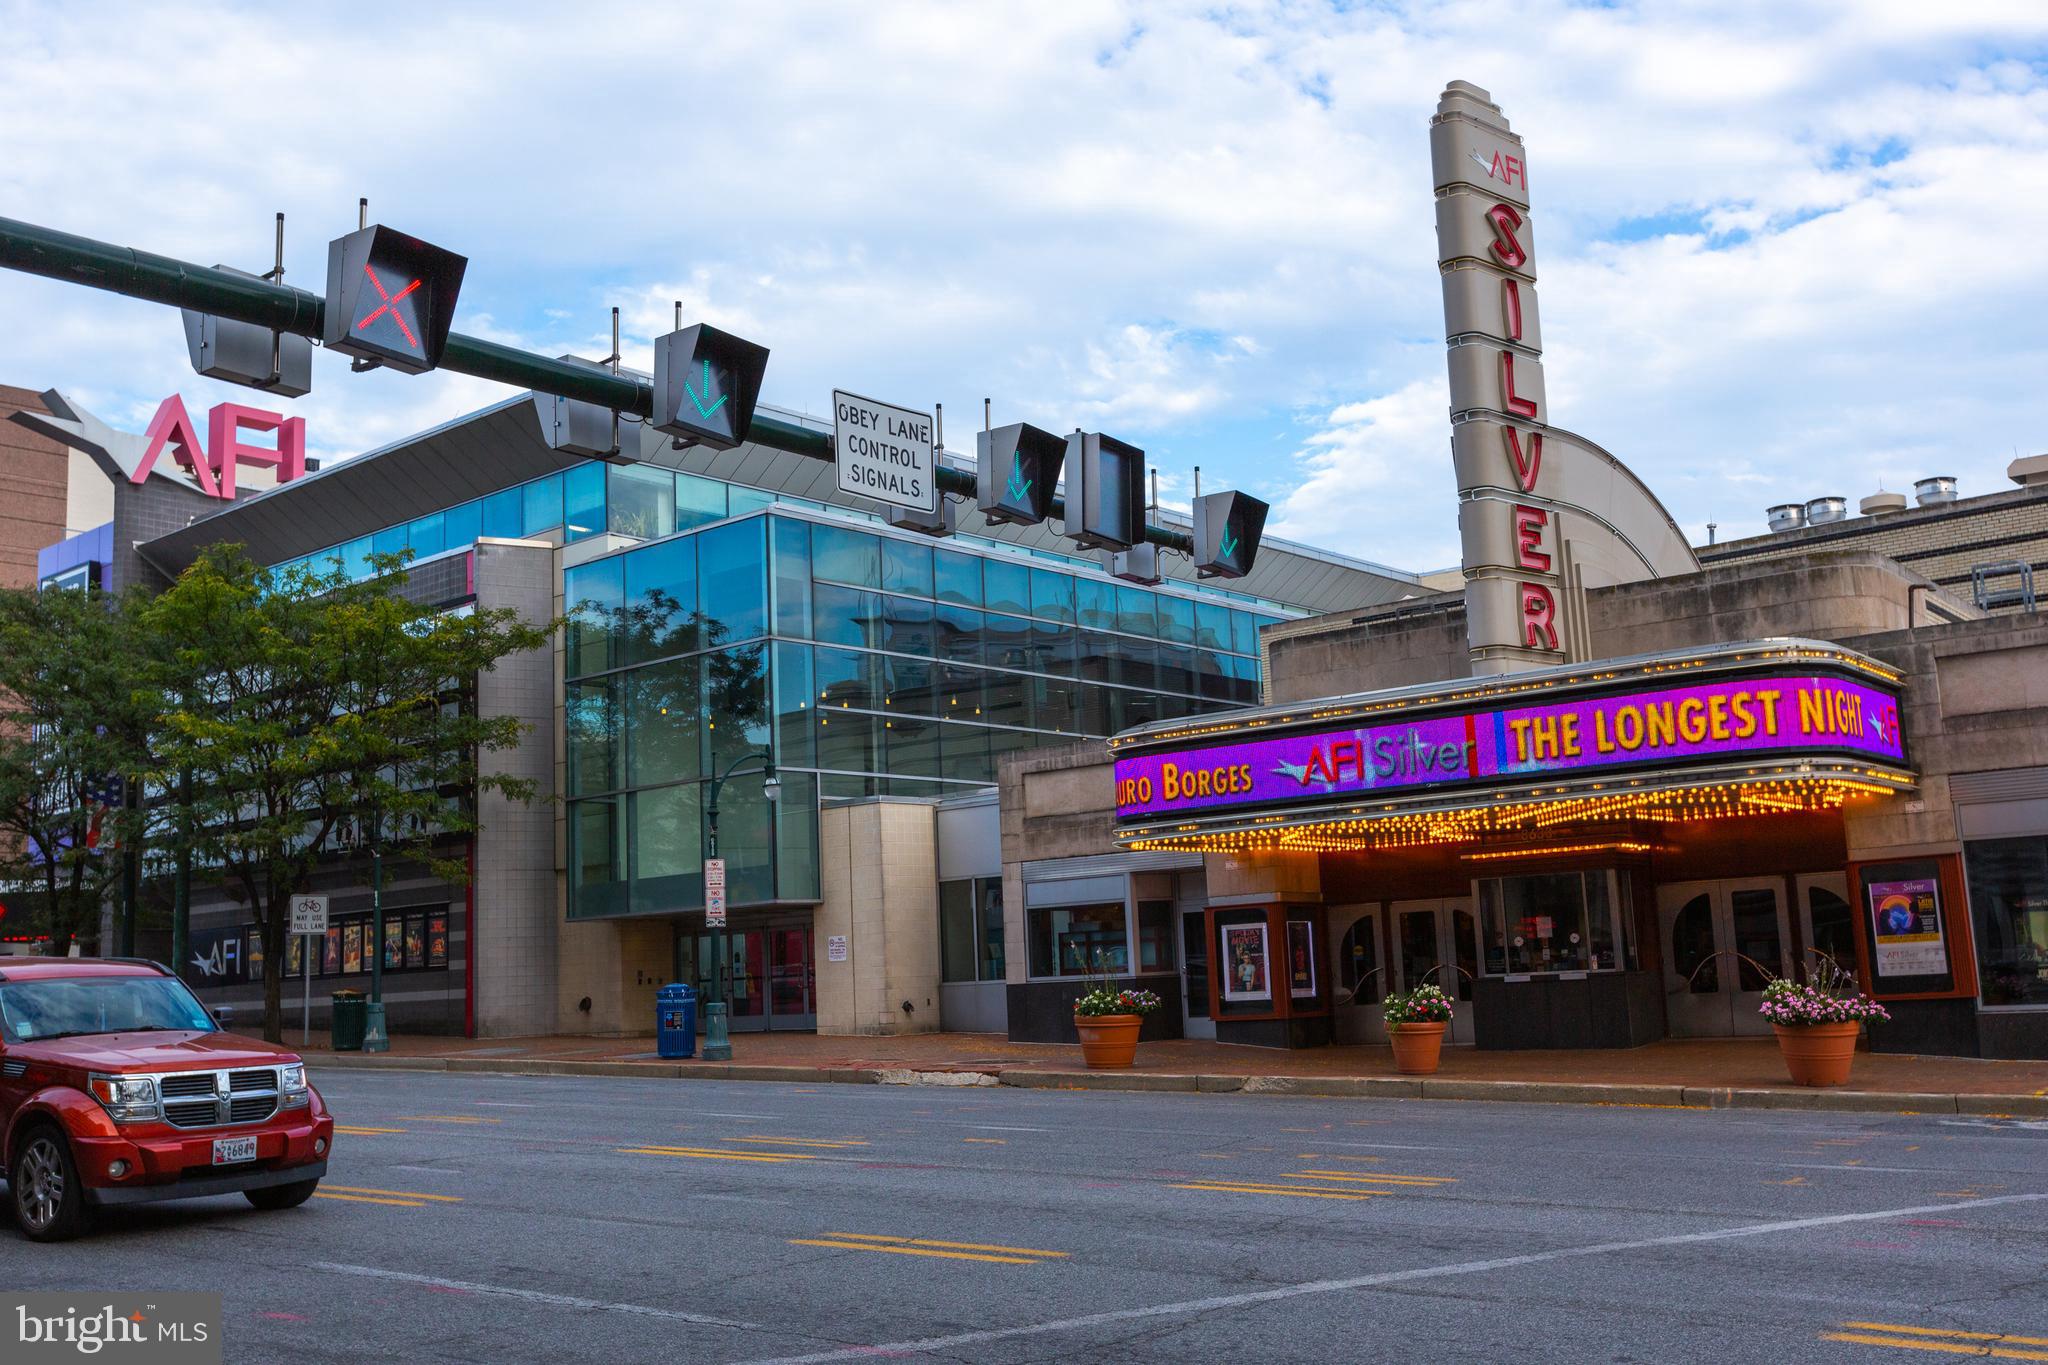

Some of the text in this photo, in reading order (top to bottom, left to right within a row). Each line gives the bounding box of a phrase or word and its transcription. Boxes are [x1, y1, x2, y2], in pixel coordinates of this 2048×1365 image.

[1489, 149, 1525, 192] AFI
[838, 403, 929, 444] OBEY LANE
[1487, 203, 1559, 650] SILVER
[129, 392, 306, 500] AFI
[848, 434, 921, 470] CONTROL
[851, 463, 920, 498] SIGNALS
[1509, 687, 1864, 762] THE LONGEST NIGHT
[1302, 727, 1475, 785] AFI Silver
[1116, 762, 1253, 806] URO BORGES
[1903, 882, 1925, 892] Silver
[293, 922, 326, 930] FULL LANE
[203, 938, 242, 977] AFI
